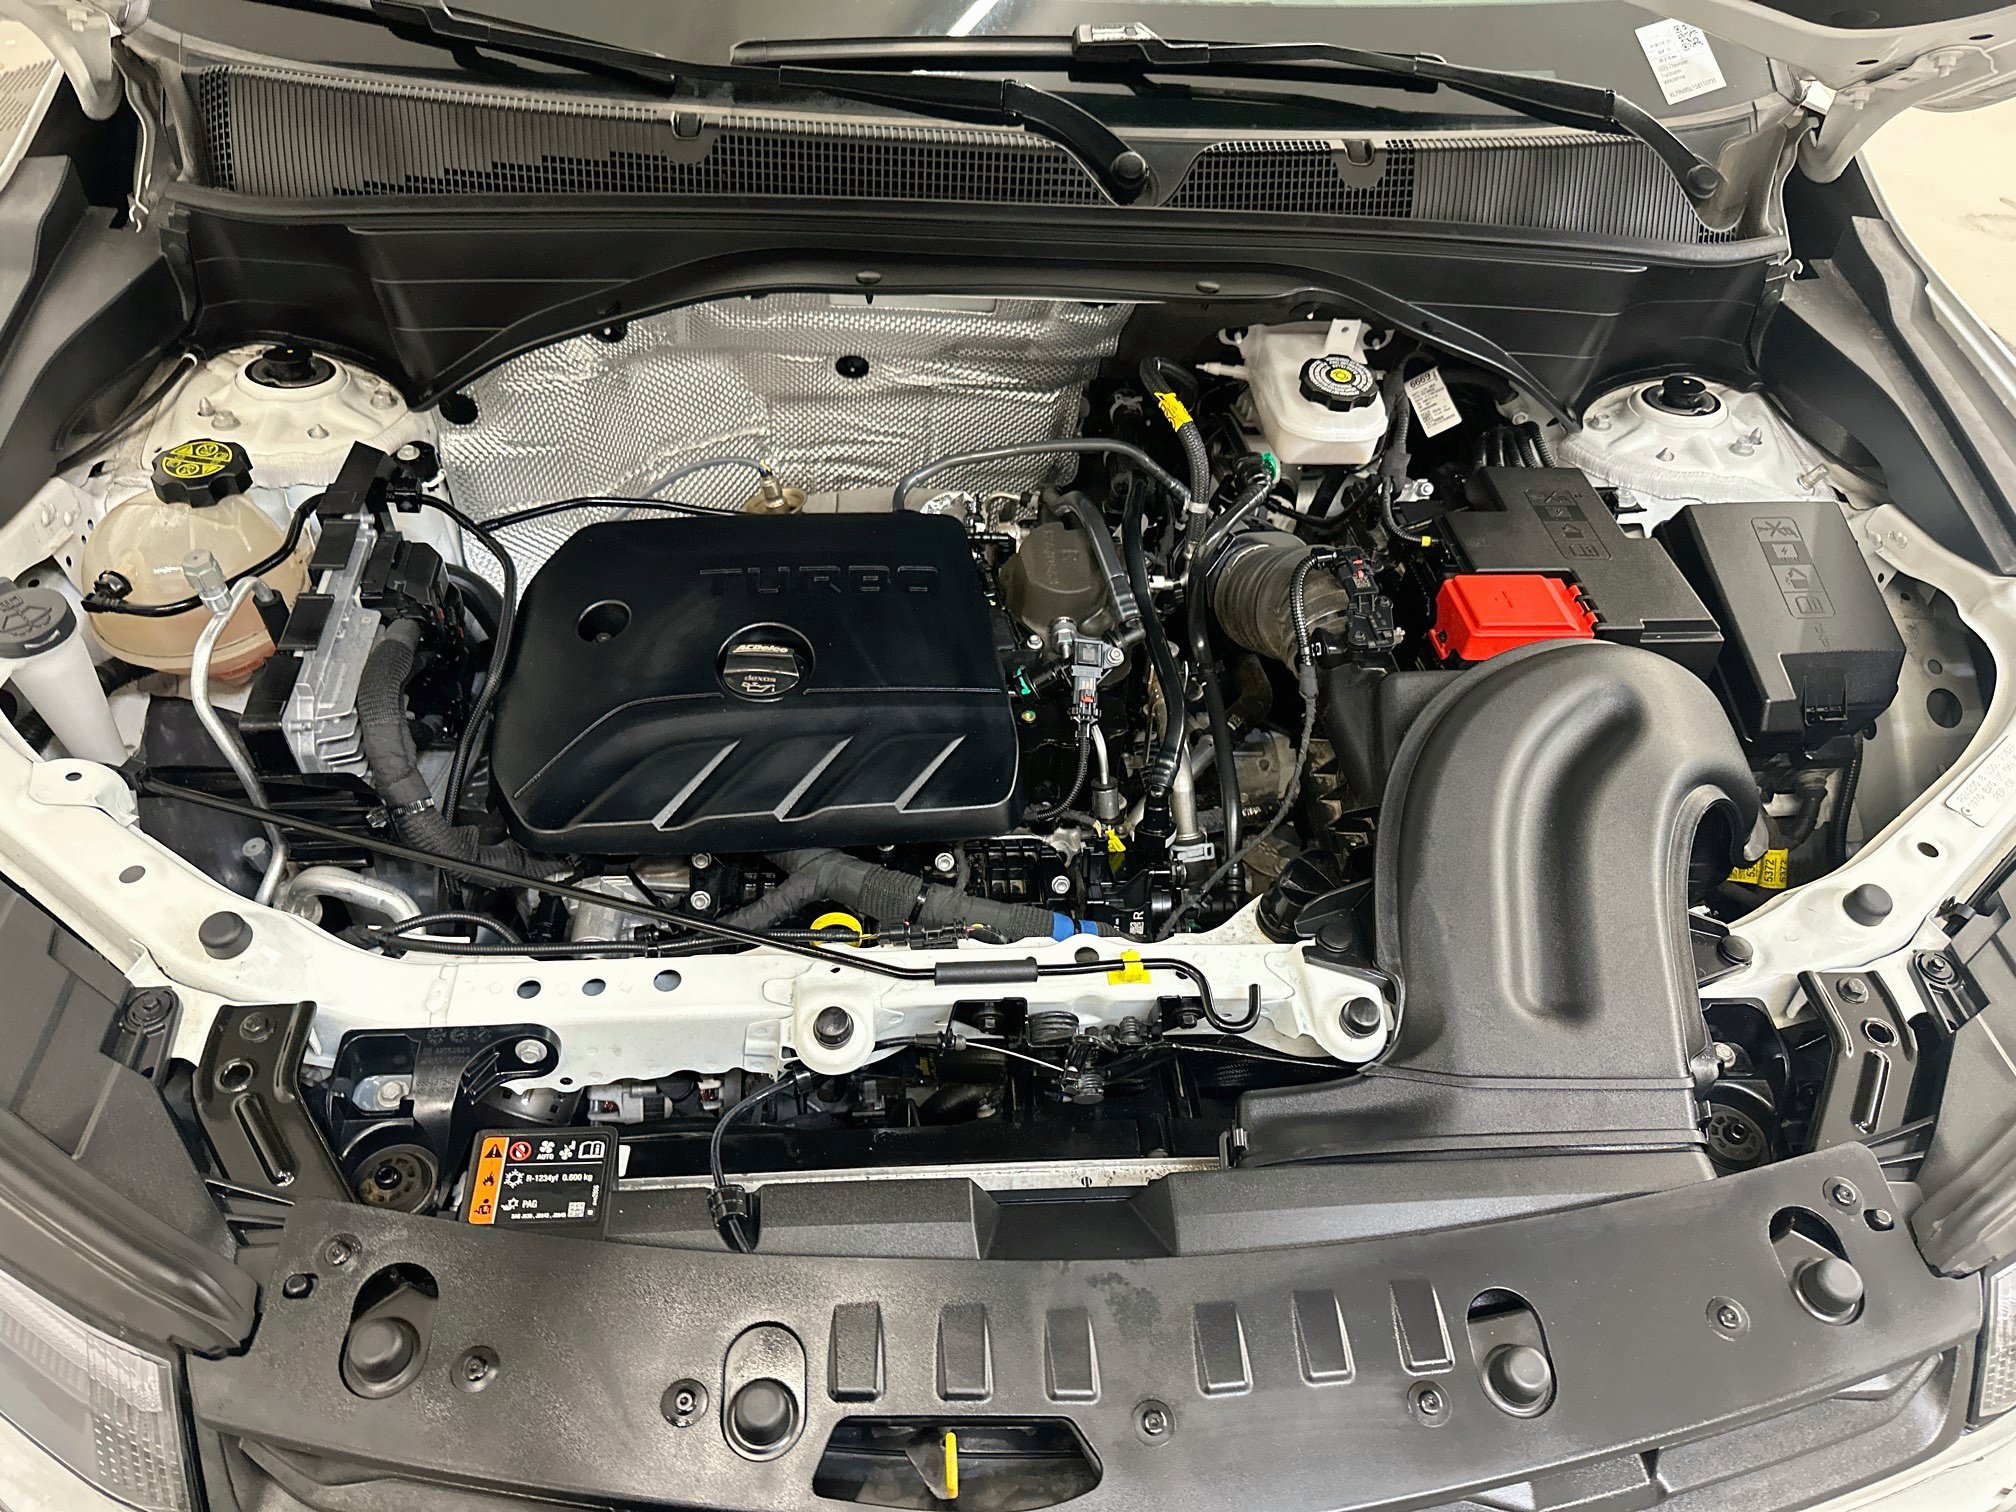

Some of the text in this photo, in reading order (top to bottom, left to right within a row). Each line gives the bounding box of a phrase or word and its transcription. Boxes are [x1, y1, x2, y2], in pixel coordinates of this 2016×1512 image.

[1410, 372, 1431, 388] 6669
[699, 565, 939, 598] TURBO
[734, 644, 789, 653] ACDelco
[744, 674, 777, 683] dexos
[1764, 859, 1775, 883] 5372
[536, 1153, 555, 1161] AUTO
[525, 1173, 559, 1184] R-1234yf
[583, 1173, 594, 1183] kg
[521, 1199, 539, 1209] PAG
